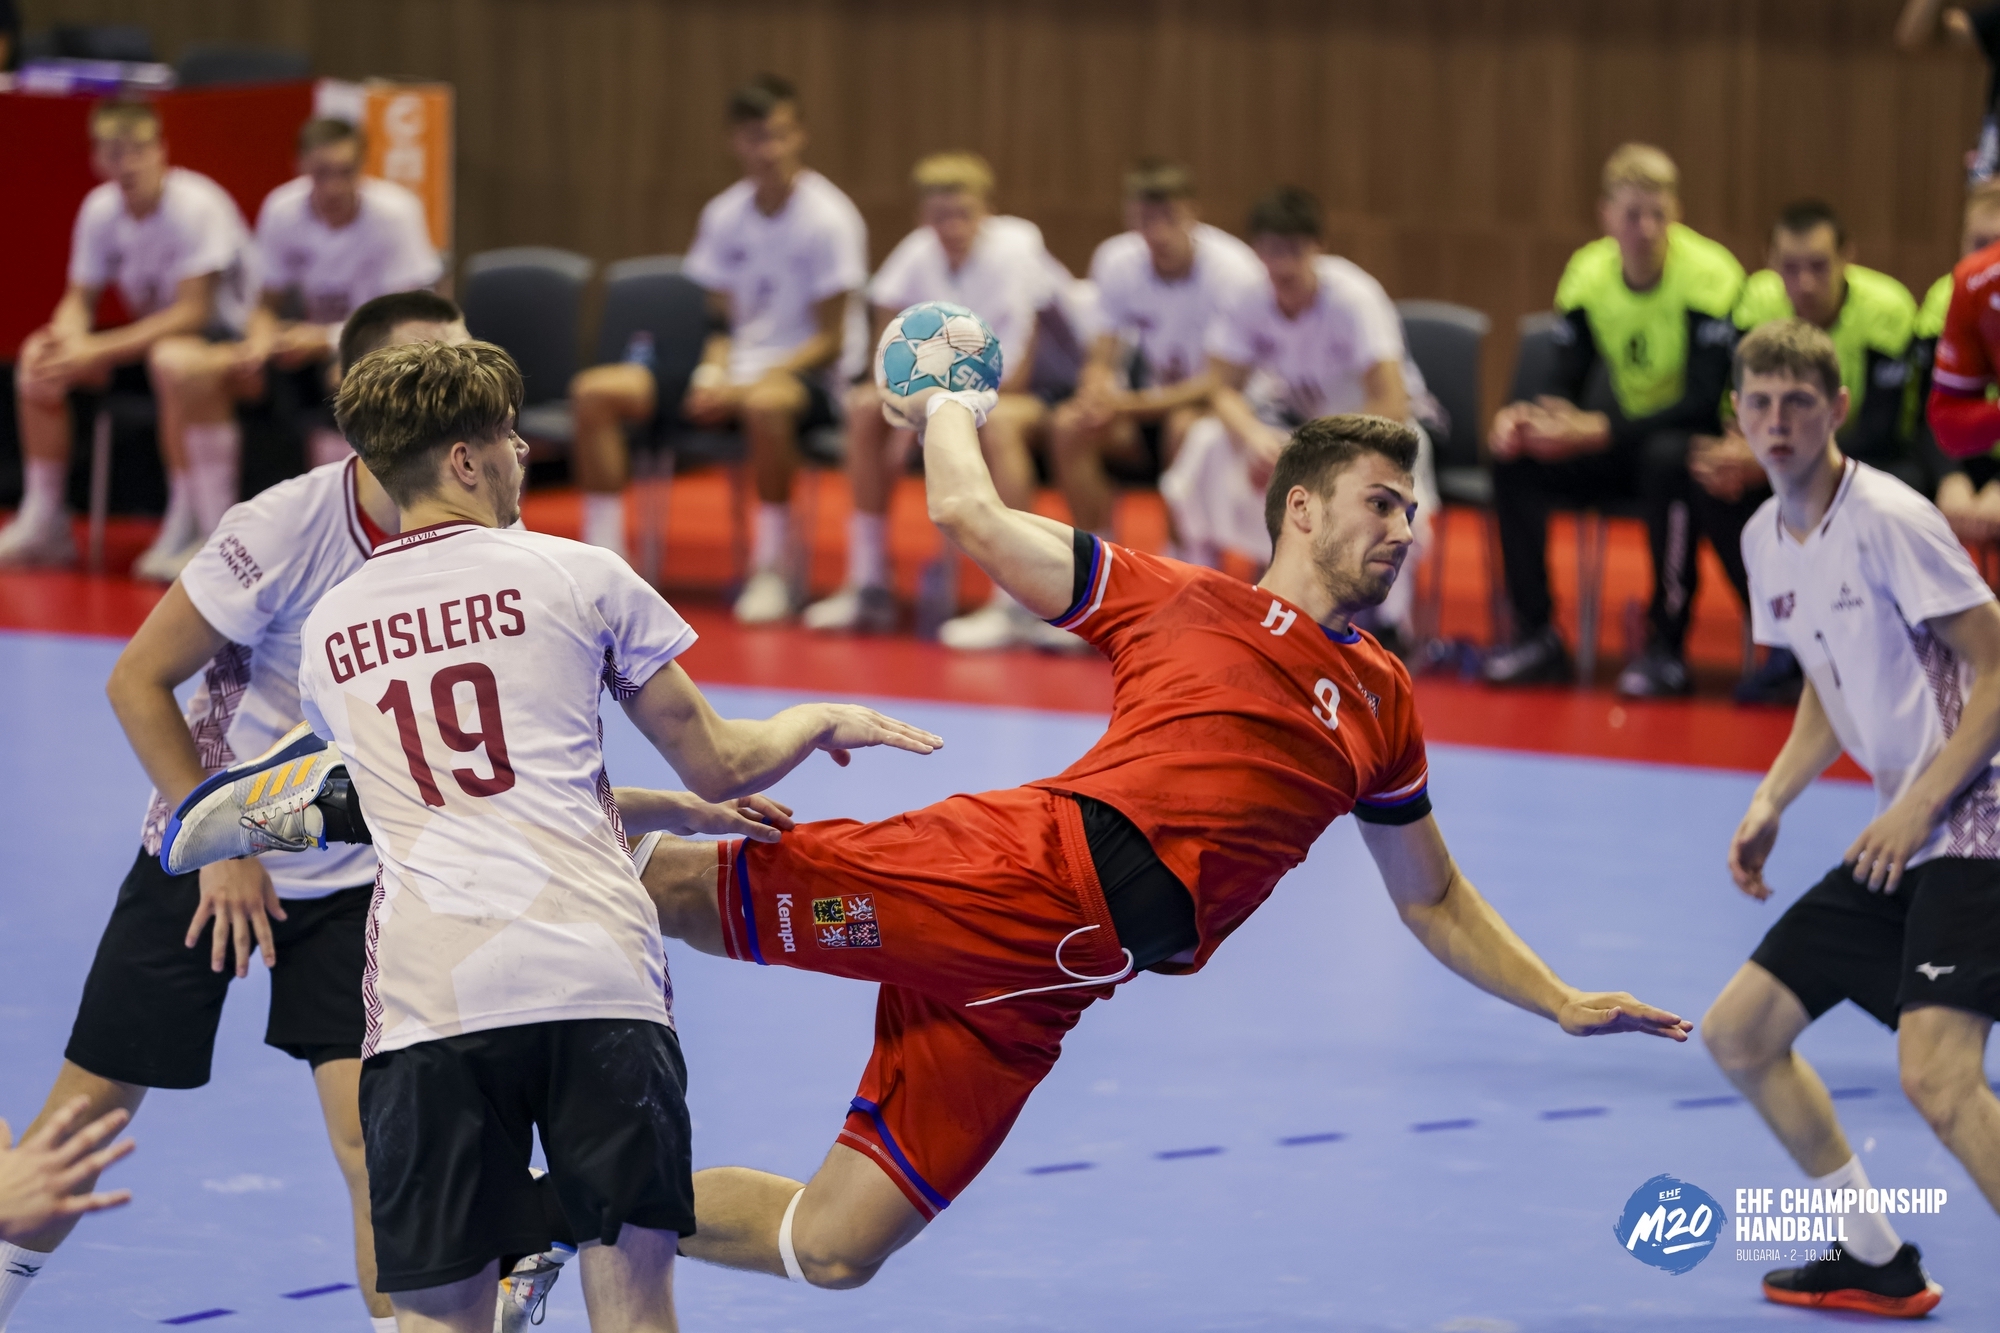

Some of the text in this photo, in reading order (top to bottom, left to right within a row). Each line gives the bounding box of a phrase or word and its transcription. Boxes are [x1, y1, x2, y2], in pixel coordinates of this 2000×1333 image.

[219, 542, 253, 590] PUNKTS
[325, 588, 526, 684] GEISLERS
[1312, 677, 1341, 731] 9
[376, 662, 516, 807] 19
[776, 893, 796, 953] Kempa
